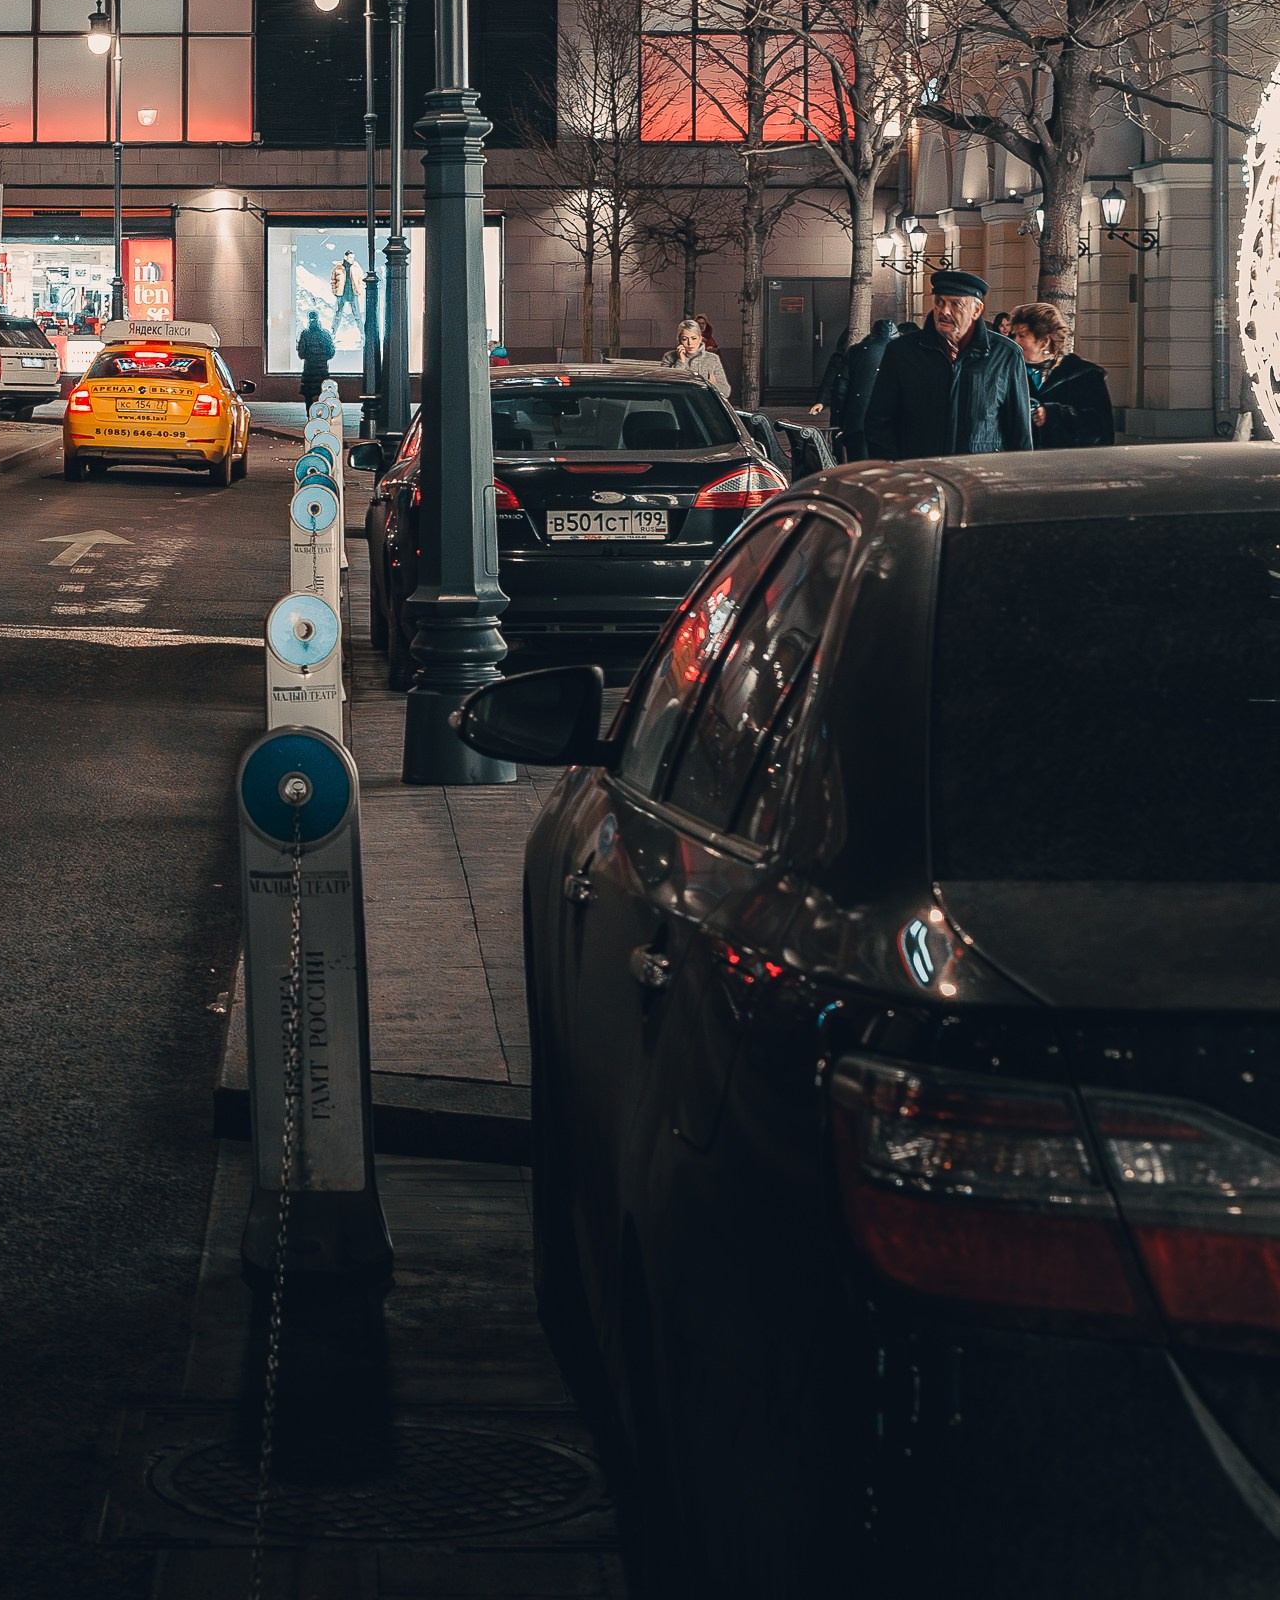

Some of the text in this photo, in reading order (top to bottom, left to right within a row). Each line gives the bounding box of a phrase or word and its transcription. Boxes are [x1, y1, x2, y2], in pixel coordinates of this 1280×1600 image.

[134, 284, 169, 305] ten
[128, 323, 190, 336] Яндекс Такси
[135, 401, 151, 409] 154
[104, 428, 130, 436] (985)
[133, 429, 186, 438] 646-40-99
[554, 512, 663, 532] В501СТ 199
[273, 690, 337, 702] МАЛЫЙ ТЕАТР
[250, 879, 351, 895] МАЛЫ ТЕАТР
[305, 951, 327, 1049] РОССИИ
